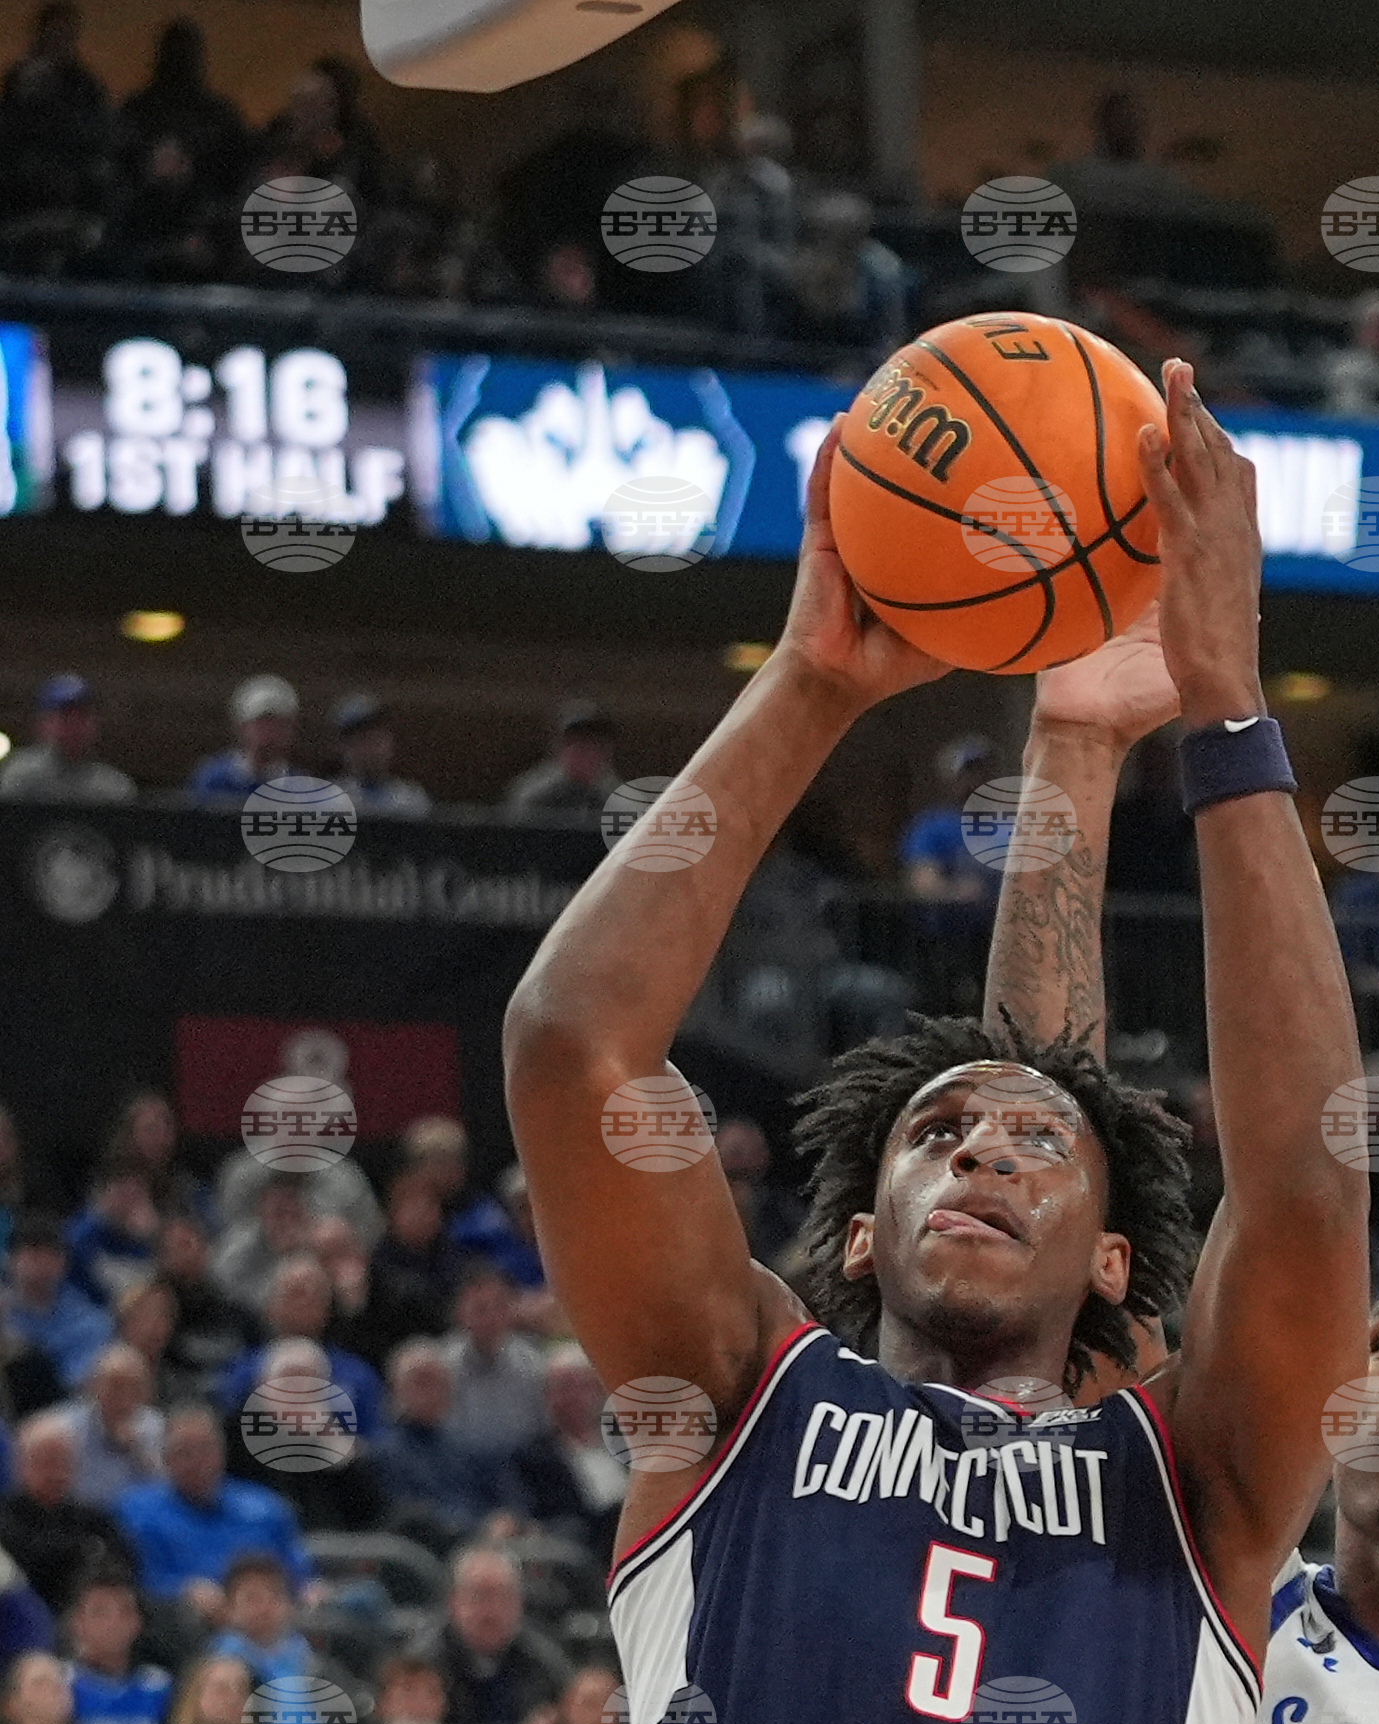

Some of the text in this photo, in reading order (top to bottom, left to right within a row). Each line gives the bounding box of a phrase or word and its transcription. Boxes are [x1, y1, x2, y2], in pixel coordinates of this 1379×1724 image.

[103, 337, 349, 446] 8:16
[66, 430, 405, 526] 1ST HALF
[905, 1540, 997, 1722] 5
